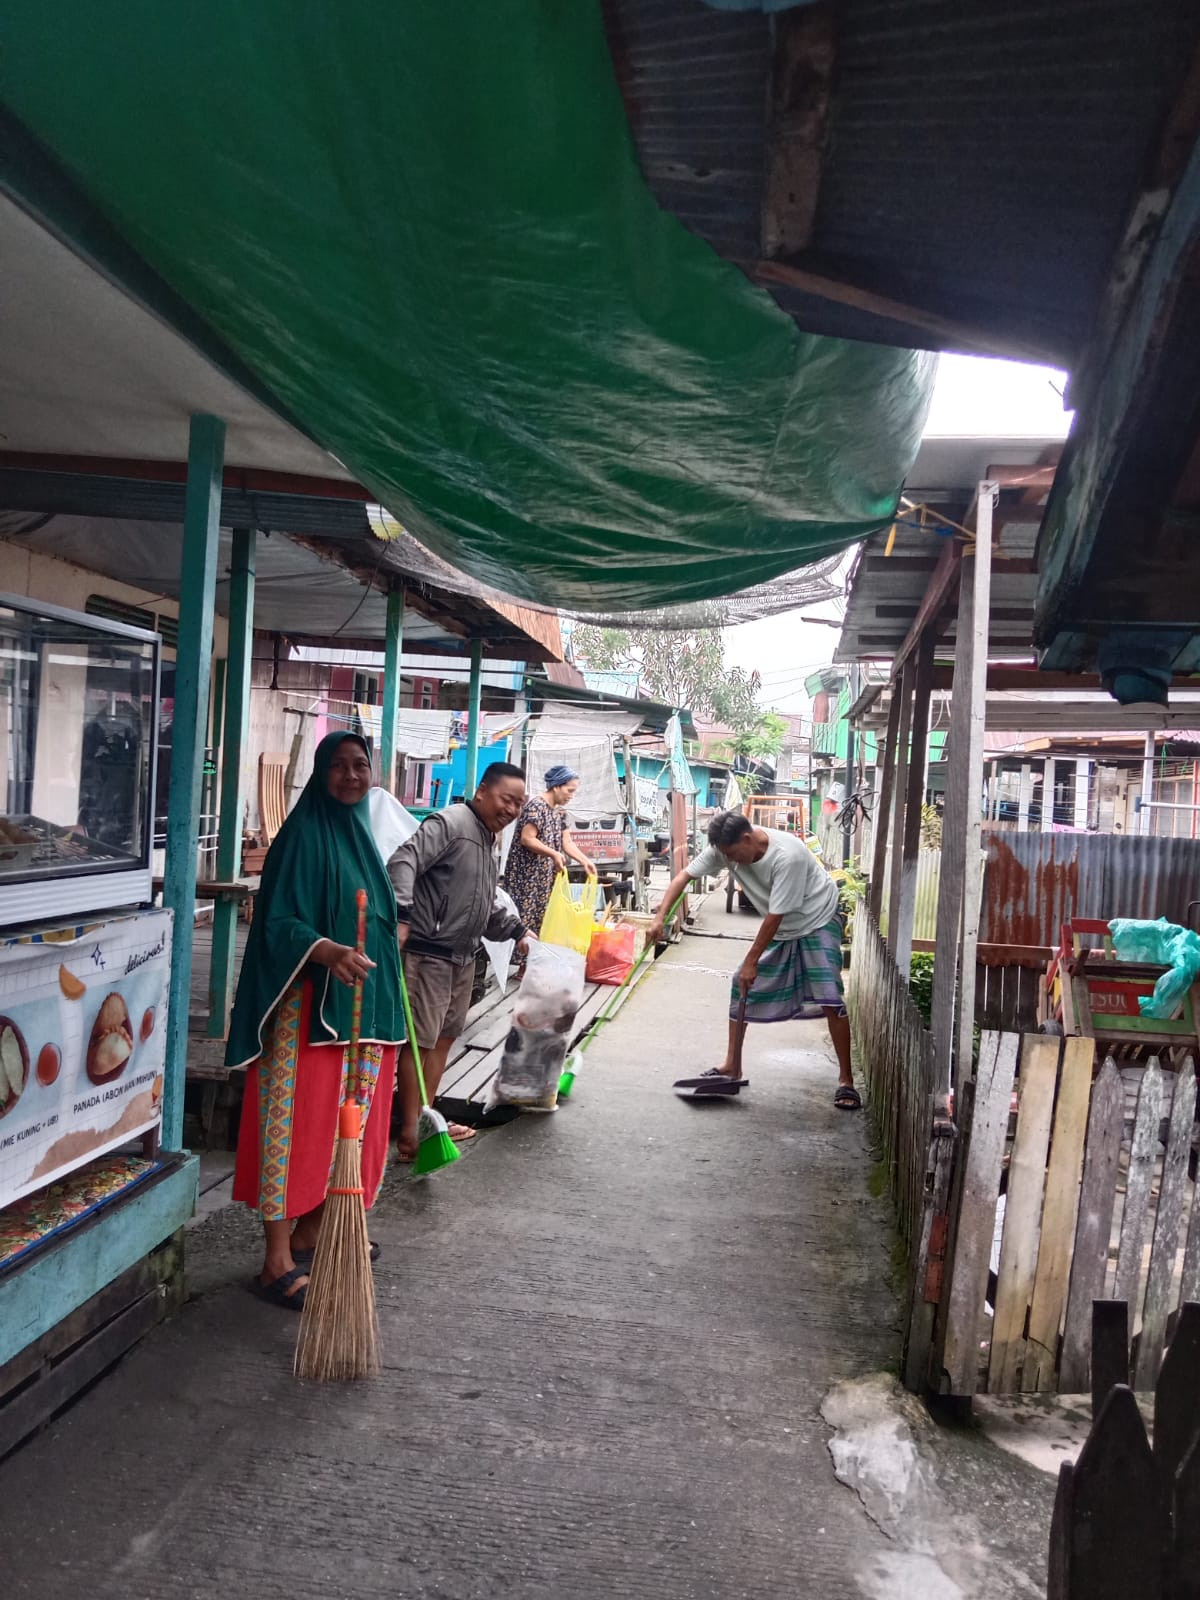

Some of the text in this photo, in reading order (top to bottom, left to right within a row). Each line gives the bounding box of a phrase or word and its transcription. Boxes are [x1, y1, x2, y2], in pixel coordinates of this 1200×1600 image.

[73, 1095, 101, 1114] PANADA
[102, 1085, 124, 1103] (ABON
[0, 1134, 16, 1151] (MIE
[17, 1122, 41, 1143] KUNING
